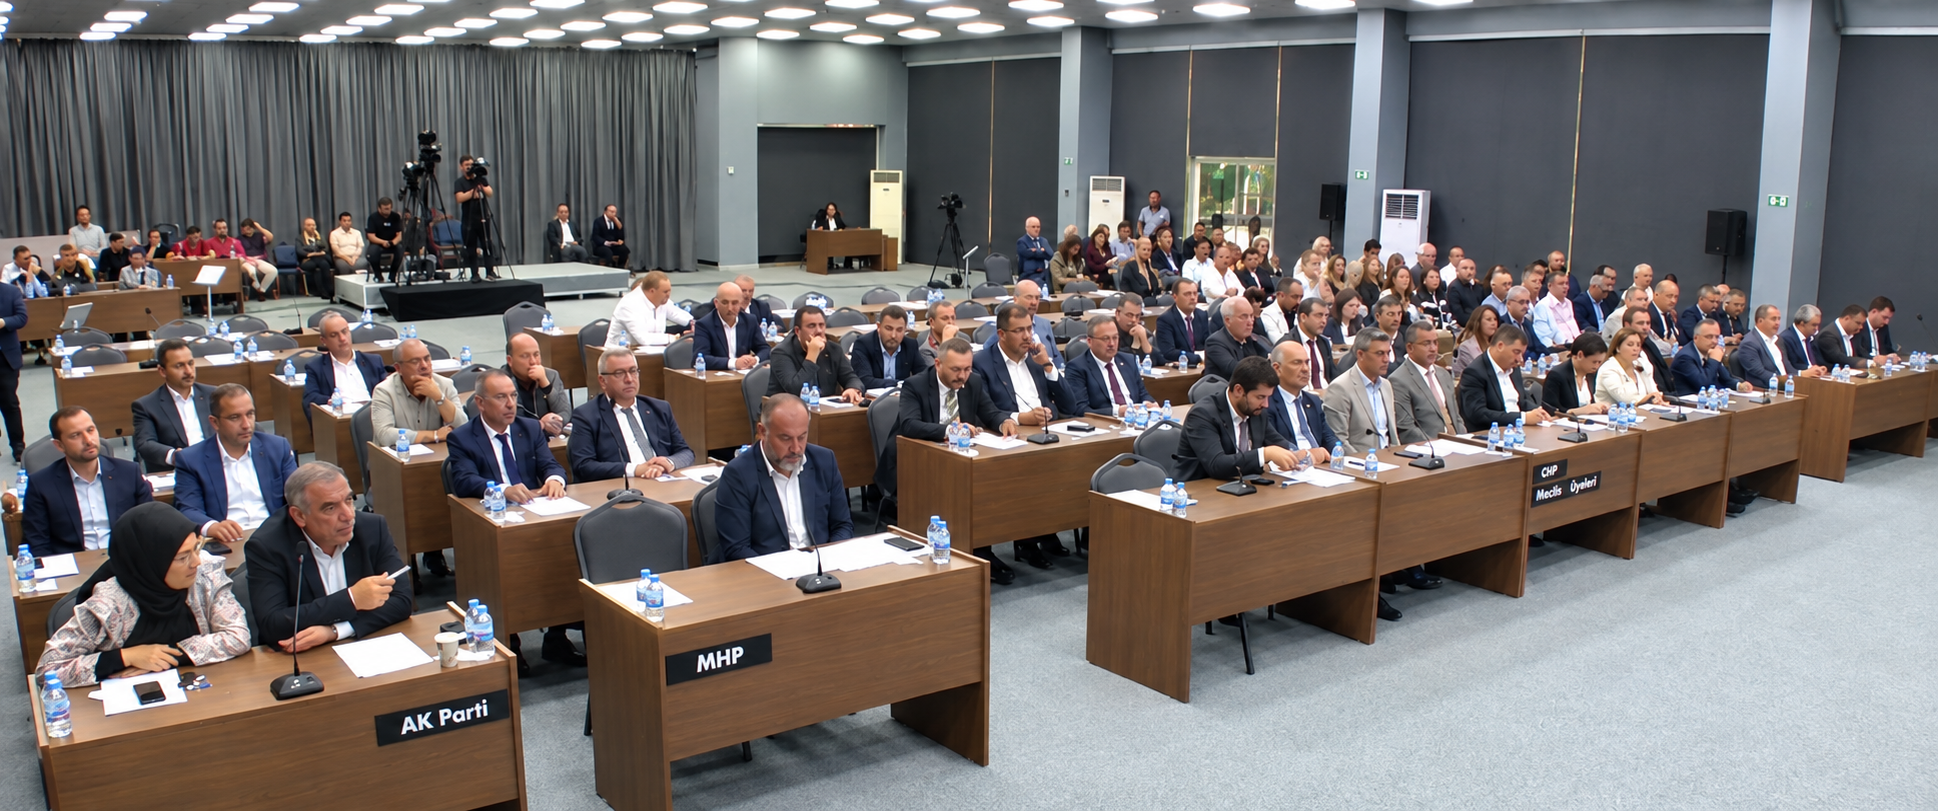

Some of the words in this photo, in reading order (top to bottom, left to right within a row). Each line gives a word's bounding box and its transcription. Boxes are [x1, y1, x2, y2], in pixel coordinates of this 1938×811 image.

[1541, 465, 1558, 478] CHP
[1536, 485, 1562, 501] Meclis
[1570, 476, 1597, 494] Üyeleri
[697, 646, 744, 673] MHP
[400, 711, 434, 735] AK
[438, 698, 489, 727] Parti
